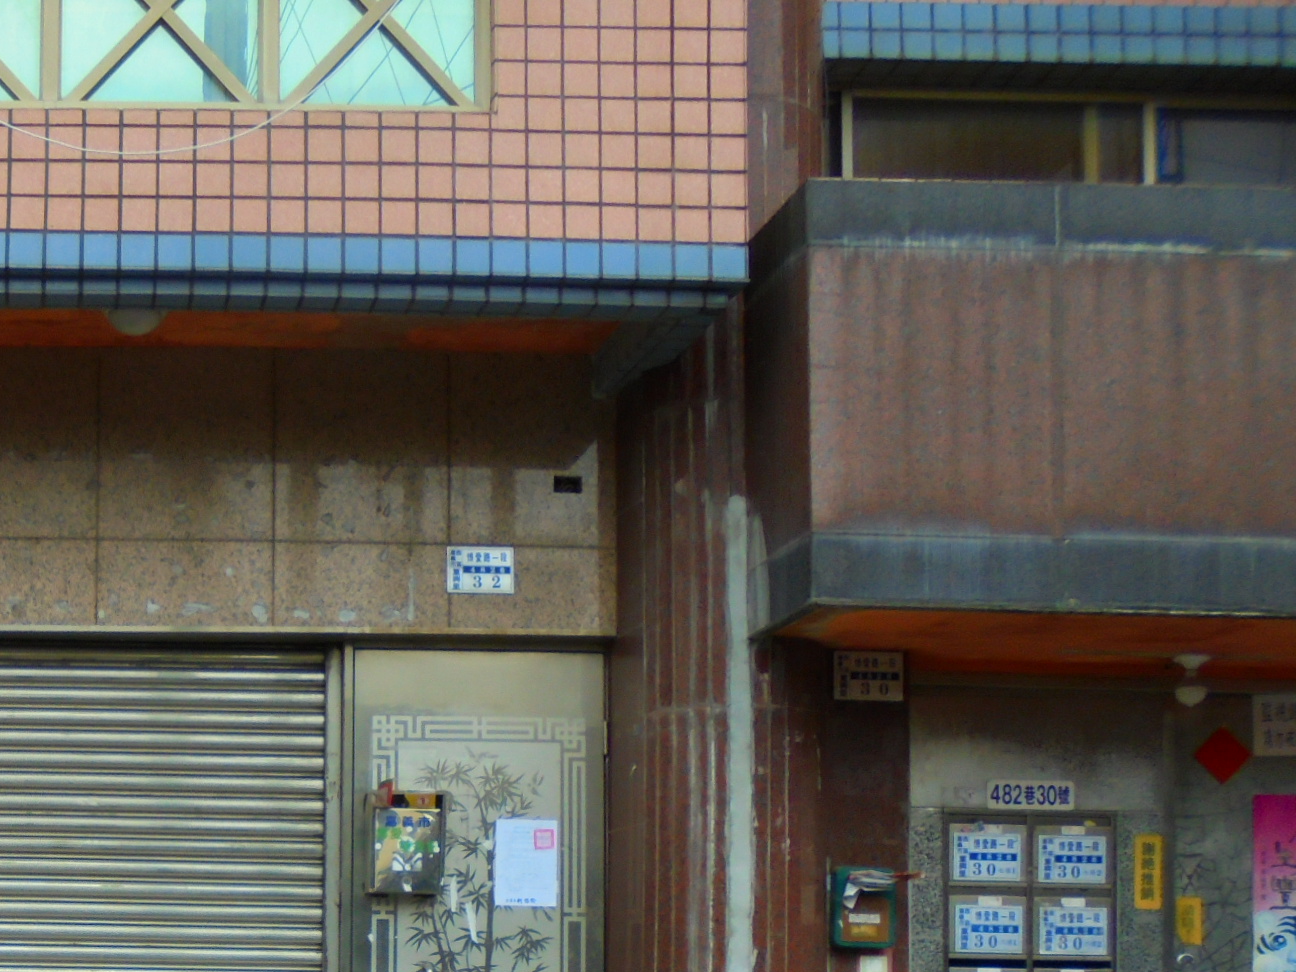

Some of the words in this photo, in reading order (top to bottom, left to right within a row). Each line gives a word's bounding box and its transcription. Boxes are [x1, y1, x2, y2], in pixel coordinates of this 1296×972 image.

[473, 575, 501, 588] 32
[860, 682, 889, 695] 30
[990, 784, 1070, 805] 482巷30號
[972, 862, 996, 876] 30
[1057, 865, 1081, 878] 30
[974, 934, 998, 948] 30
[1058, 936, 1082, 950] 30
